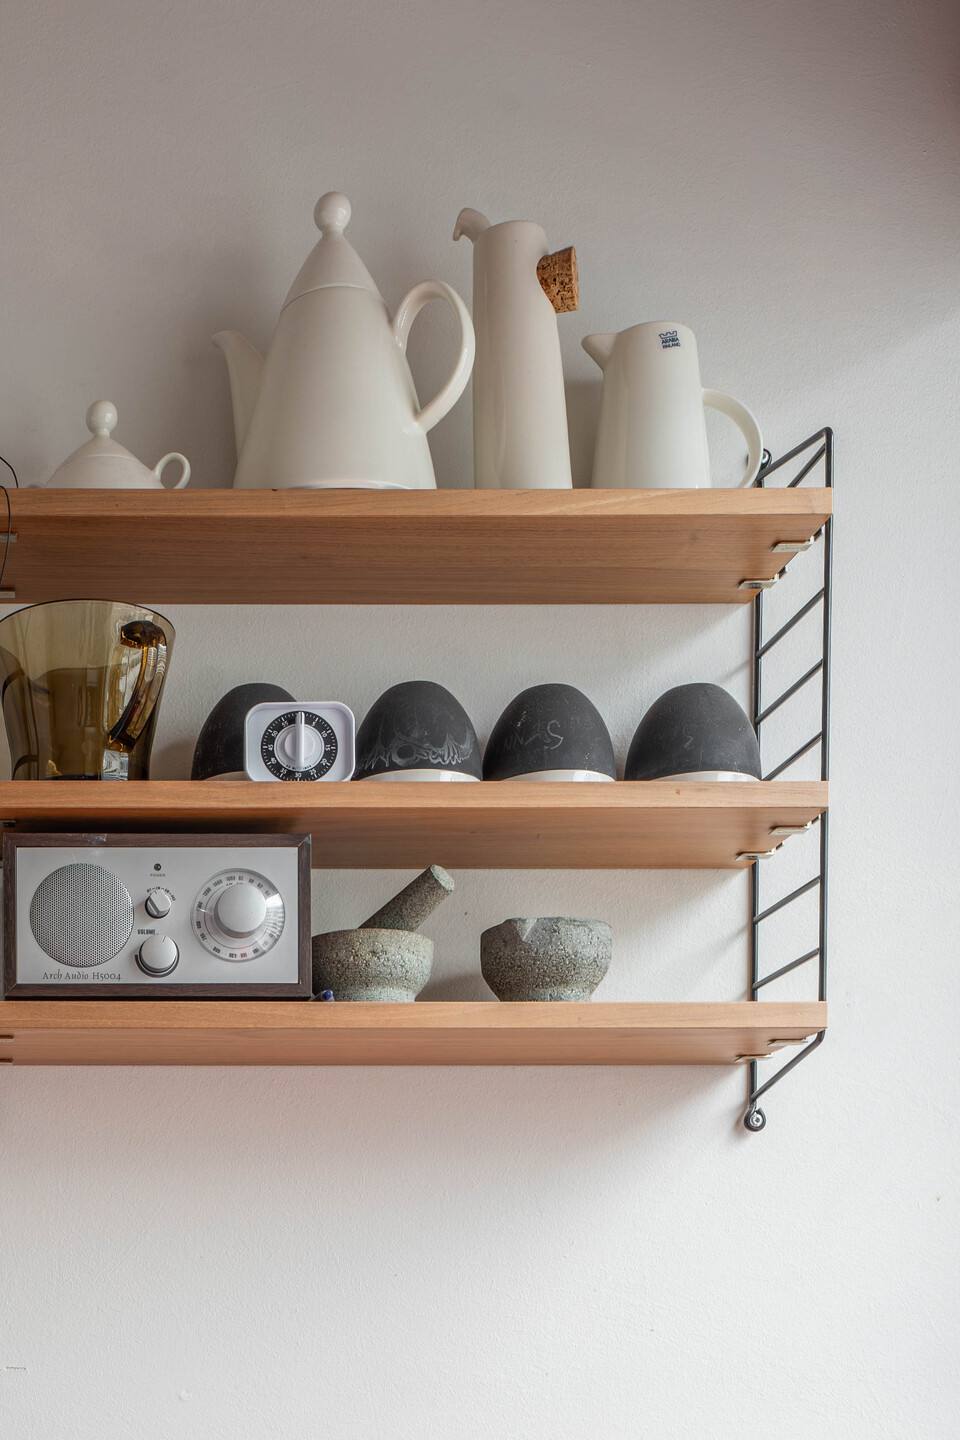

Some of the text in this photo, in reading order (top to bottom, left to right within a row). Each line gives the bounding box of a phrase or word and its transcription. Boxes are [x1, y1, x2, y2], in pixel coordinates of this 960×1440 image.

[43, 969, 121, 981] Arch Audio H5004
